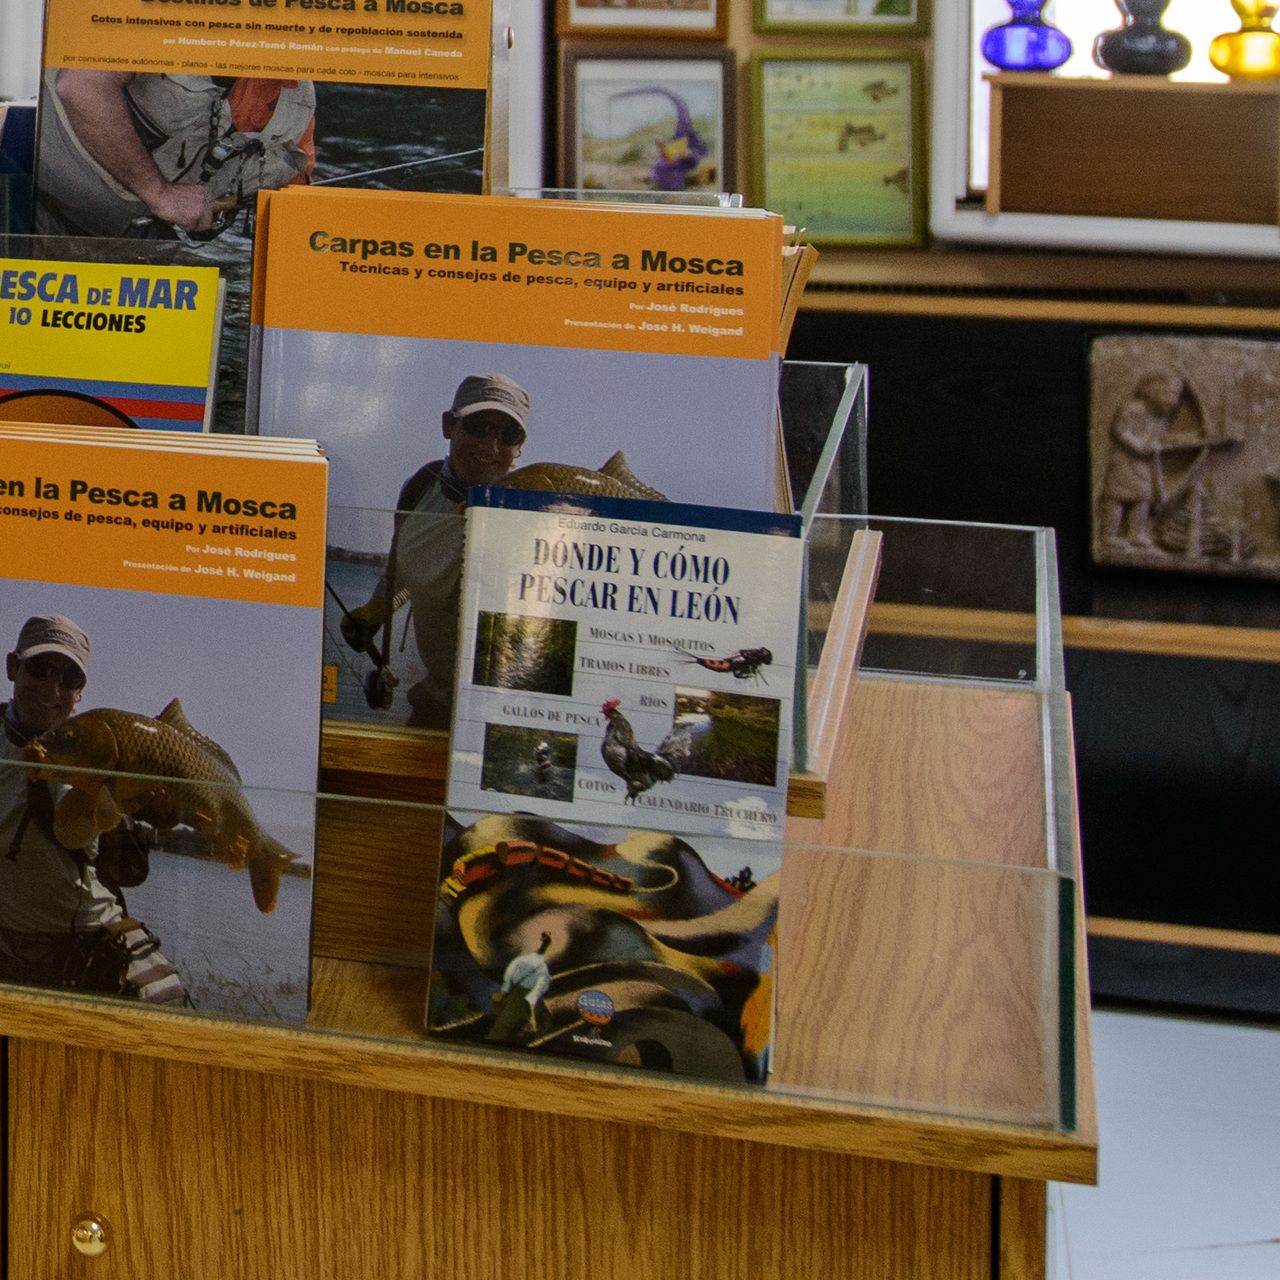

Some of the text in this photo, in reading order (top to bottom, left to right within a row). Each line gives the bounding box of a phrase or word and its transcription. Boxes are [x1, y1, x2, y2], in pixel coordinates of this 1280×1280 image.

[91, 14, 463, 40] Cotos intensivos con pesca sin muerte y de repoblación sostenida
[178, 37, 227, 47] Humberto
[385, 46, 421, 56] Manuel
[424, 49, 463, 59] Caneda
[63, 55, 76, 63] por
[78, 55, 129, 65] comunidades
[182, 59, 208, 69] planos
[215, 61, 227, 69] las
[229, 63, 261, 72] mejores
[263, 65, 295, 73] moscas
[296, 67, 315, 75] para
[317, 67, 337, 75] cada
[339, 68, 356, 76] coto
[364, 69, 396, 78] moscas
[398, 71, 417, 81] para
[418, 70, 460, 81] intensivos
[309, 230, 744, 277] Carpas en la Pesca a Mosca
[339, 261, 744, 296] Técnicas y consejos de pesca, equipo y artificiales
[87, 287, 112, 306] DE
[117, 276, 199, 311] MAR
[629, 302, 643, 310] Por
[646, 302, 676, 313] José
[9, 307, 32, 326] 10
[40, 309, 146, 334] LECCIONES
[624, 322, 635, 330] de
[638, 321, 669, 332] José
[672, 322, 685, 333] H.
[689, 323, 743, 337] Weigand
[35, 477, 59, 500] la
[70, 480, 158, 508] Pesca
[168, 493, 186, 511] a
[197, 489, 297, 521] Mosca
[64, 510, 82, 522] de
[87, 513, 137, 529] pesca,
[142, 518, 193, 533] equipo
[198, 524, 207, 535] y
[212, 523, 297, 540] artificiales
[558, 518, 607, 533] Eduardo
[651, 526, 706, 543] Carmona
[185, 544, 200, 553] Por
[202, 544, 231, 556] José
[533, 533, 730, 586] DÓNDE Y CÓMO
[123, 559, 296, 584] Presentación de José H. Weigand
[518, 572, 741, 625] PESCAR EN LEÓN
[590, 627, 715, 652] MOSCAS Y MOSQUITOS
[579, 655, 670, 677] TRAMOS LIBRES
[502, 704, 602, 728] GALLOS DE PESCA
[578, 778, 617, 794] COTOS
[638, 794, 710, 814] CALENDARIO
